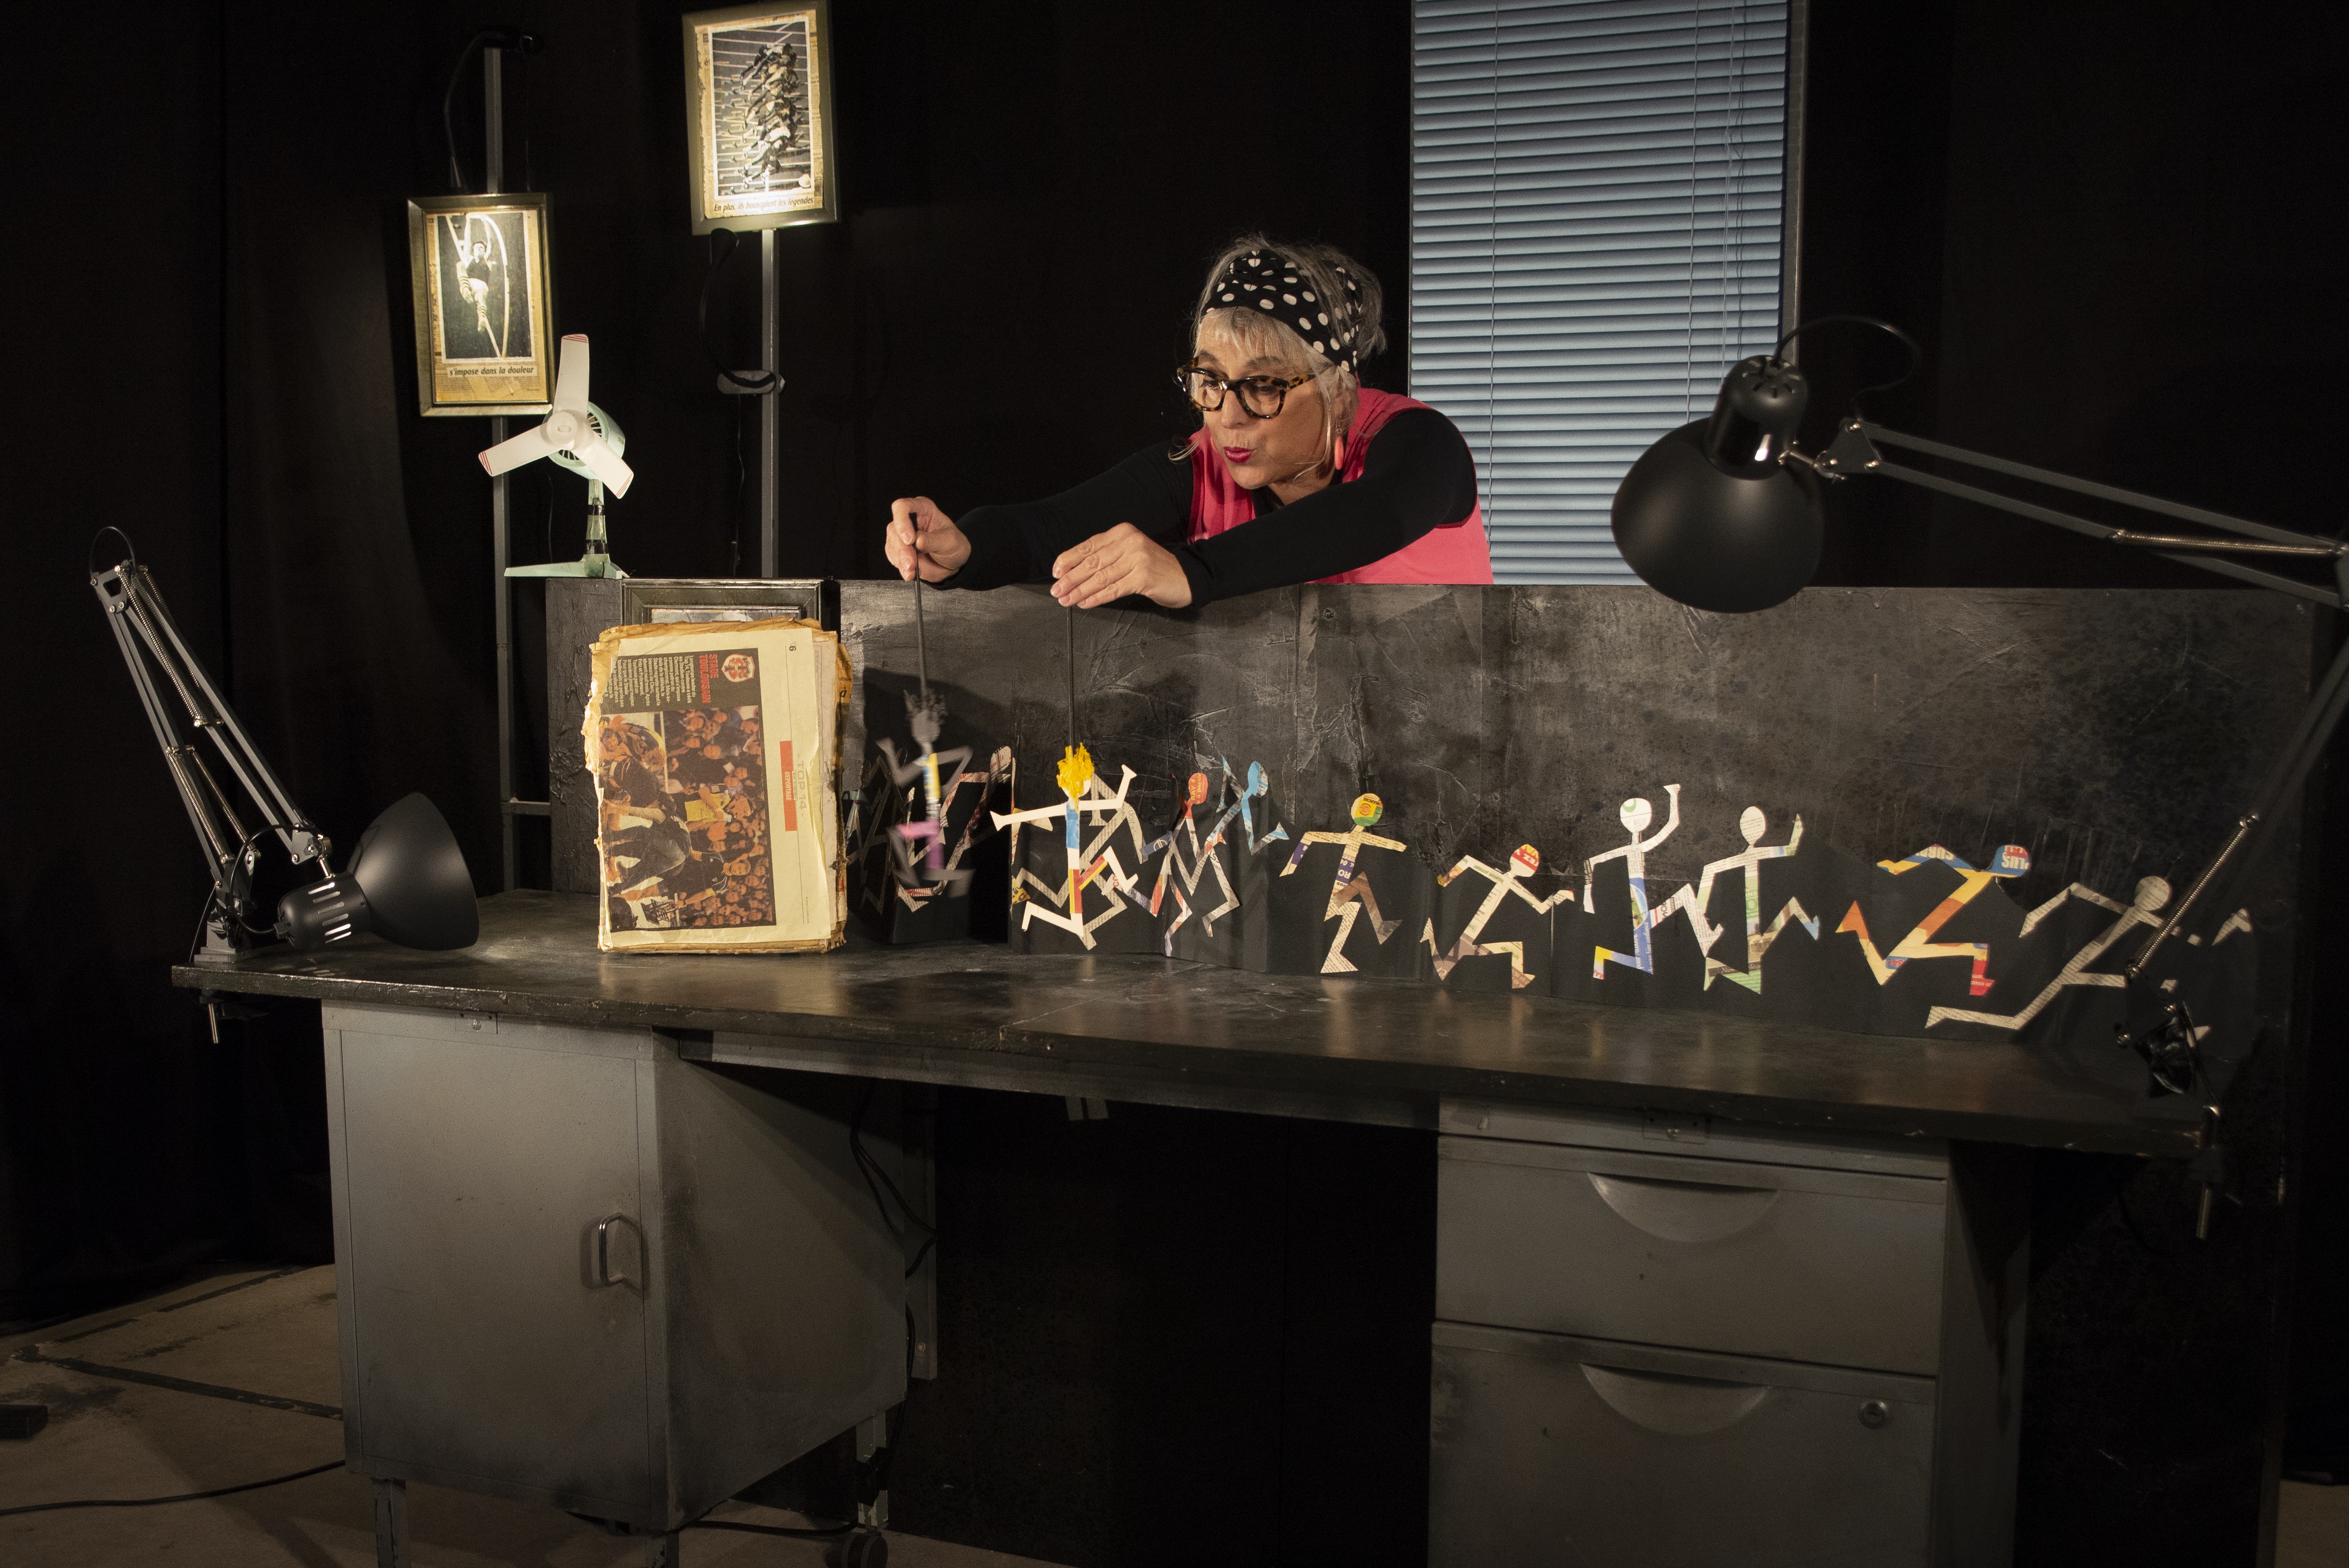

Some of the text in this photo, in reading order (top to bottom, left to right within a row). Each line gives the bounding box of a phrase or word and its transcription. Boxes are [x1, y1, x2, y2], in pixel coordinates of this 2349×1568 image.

[714, 203, 721, 211] En
[746, 200, 777, 210] bousculent
[450, 368, 479, 378] s'impose
[508, 366, 534, 374] douleur
[709, 654, 718, 679] STADE
[699, 654, 711, 703] TOULOUSAIN
[797, 761, 806, 789] TOP
[784, 771, 792, 801] REPORTAGE
[1338, 869, 1351, 880] RO
[1634, 957, 1644, 969] pour
